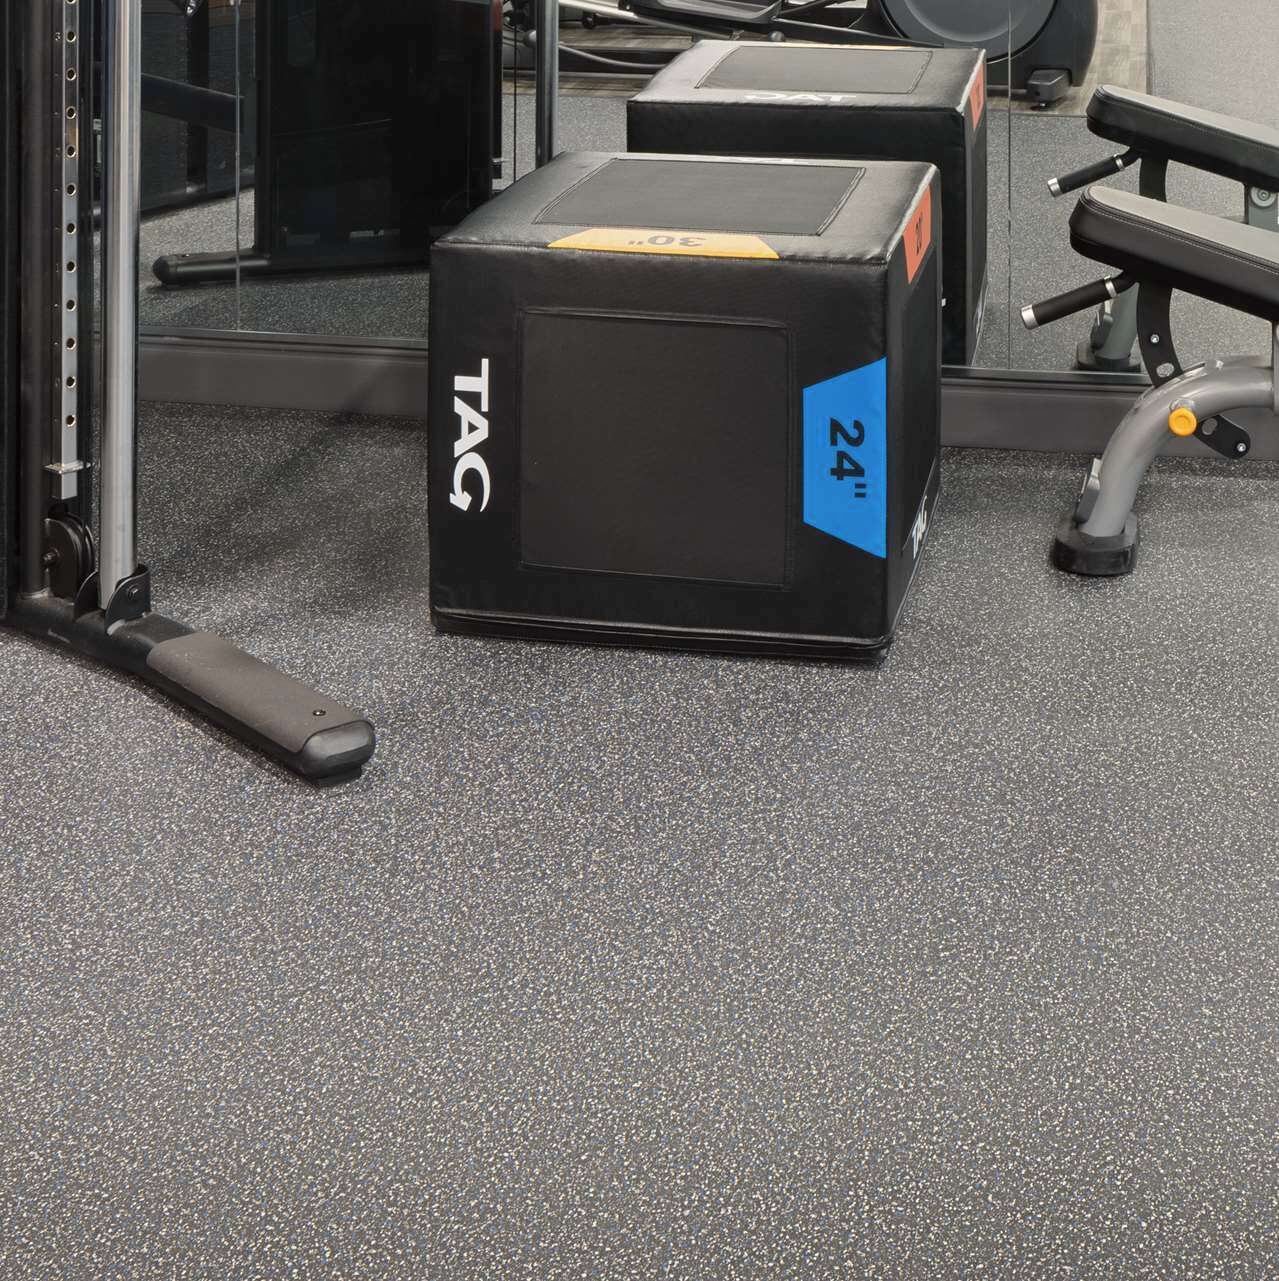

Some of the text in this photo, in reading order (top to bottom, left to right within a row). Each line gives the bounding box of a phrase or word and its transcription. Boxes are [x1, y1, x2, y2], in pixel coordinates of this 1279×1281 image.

[627, 234, 707, 248] 30"
[449, 358, 491, 513] TAG
[829, 417, 867, 499] 24"
[911, 495, 928, 561] TAG
